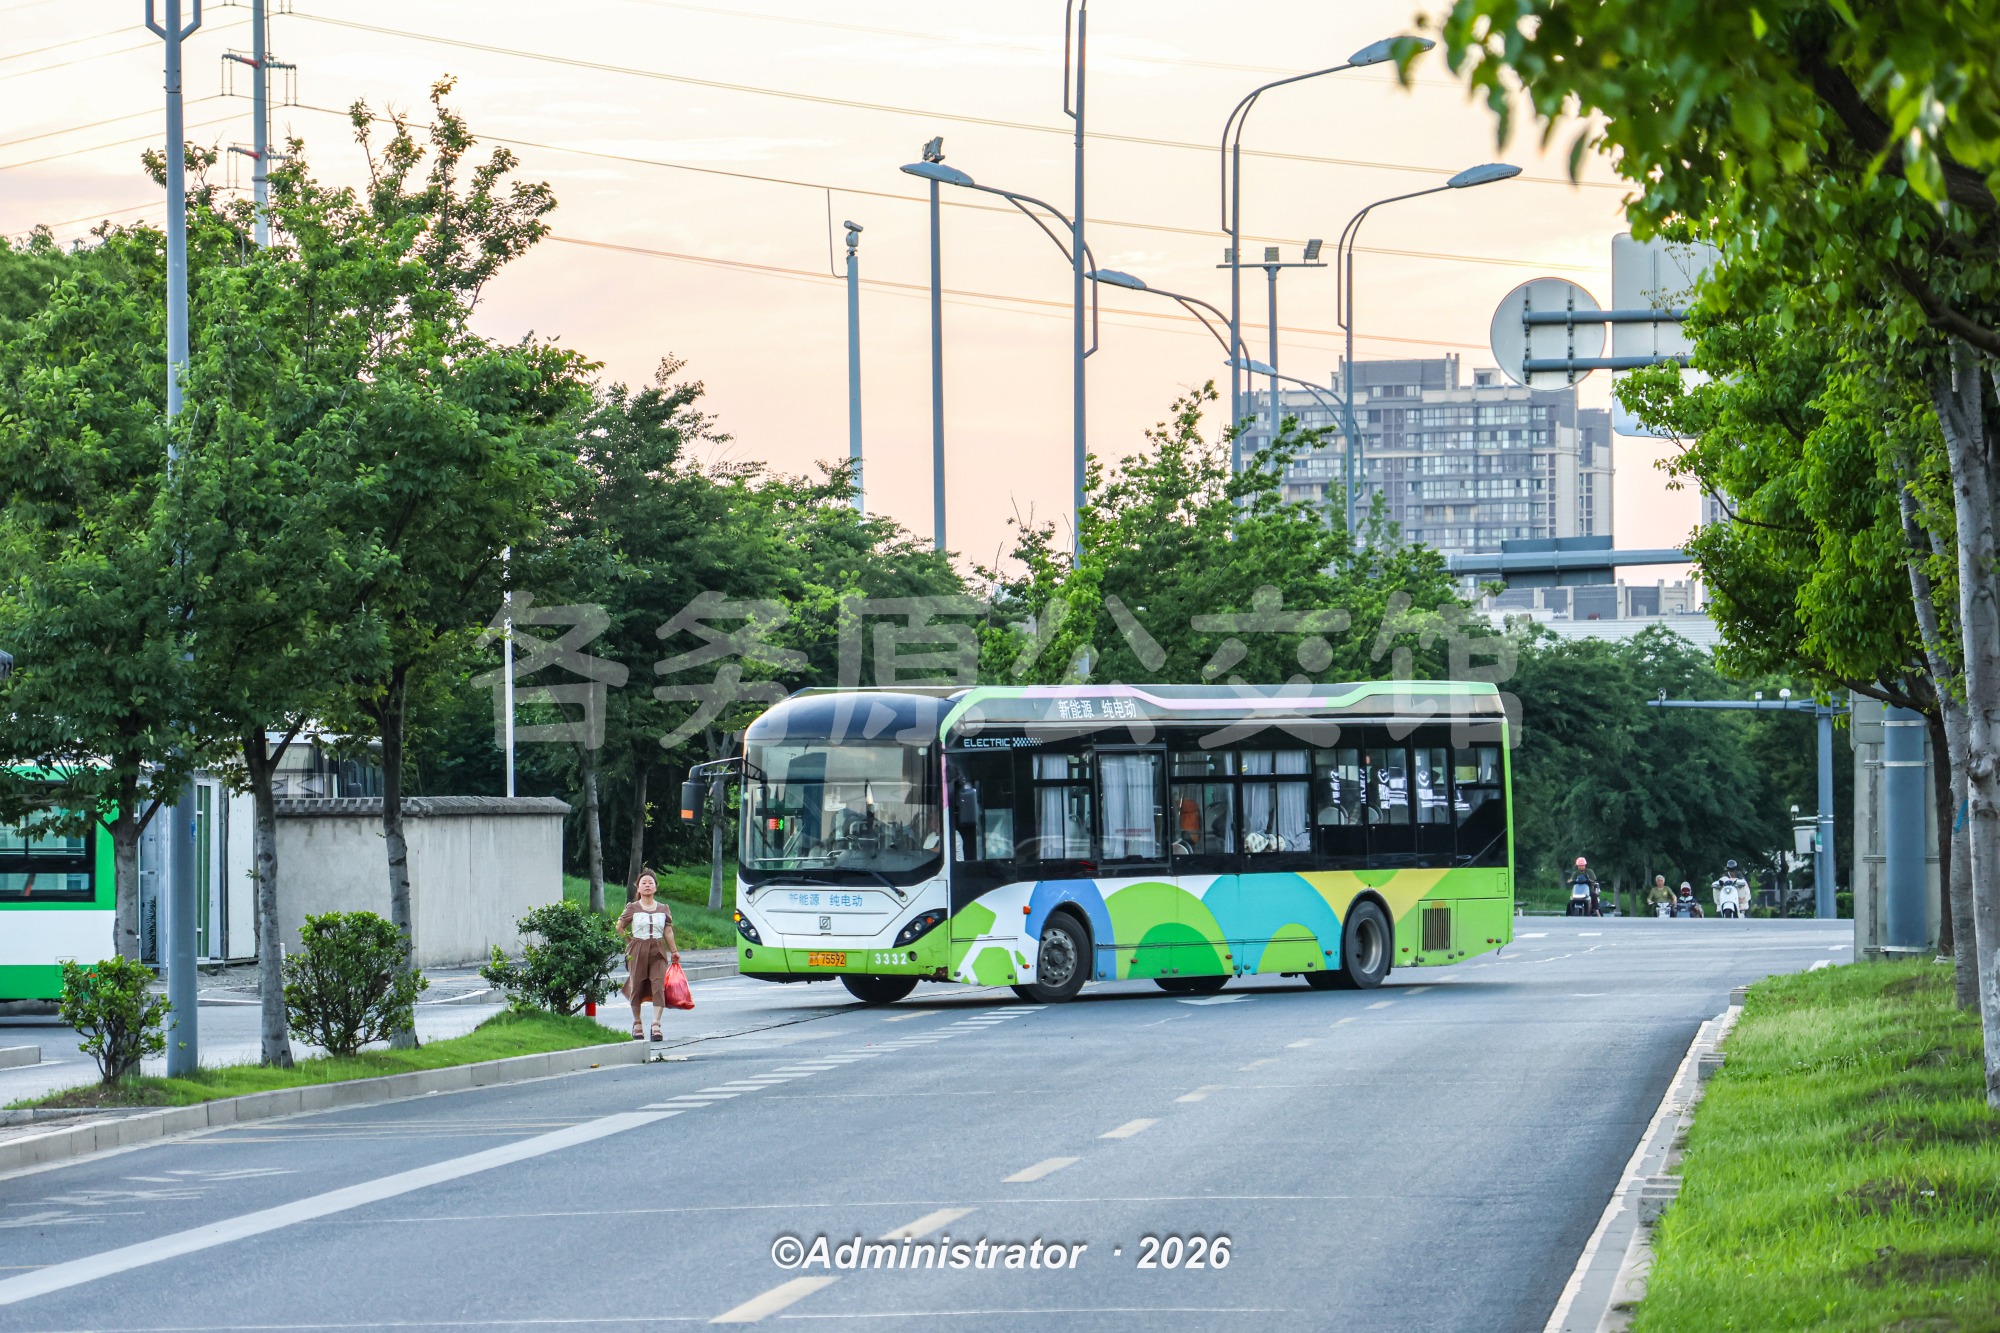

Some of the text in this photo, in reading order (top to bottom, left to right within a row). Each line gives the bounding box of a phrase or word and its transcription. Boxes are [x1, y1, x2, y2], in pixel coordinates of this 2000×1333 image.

[1058, 699, 1137, 720] 新能源 纯电动
[964, 738, 1011, 748] ELECTRIC
[789, 894, 863, 907] 新能源 纯电动
[875, 953, 907, 965] 3332
